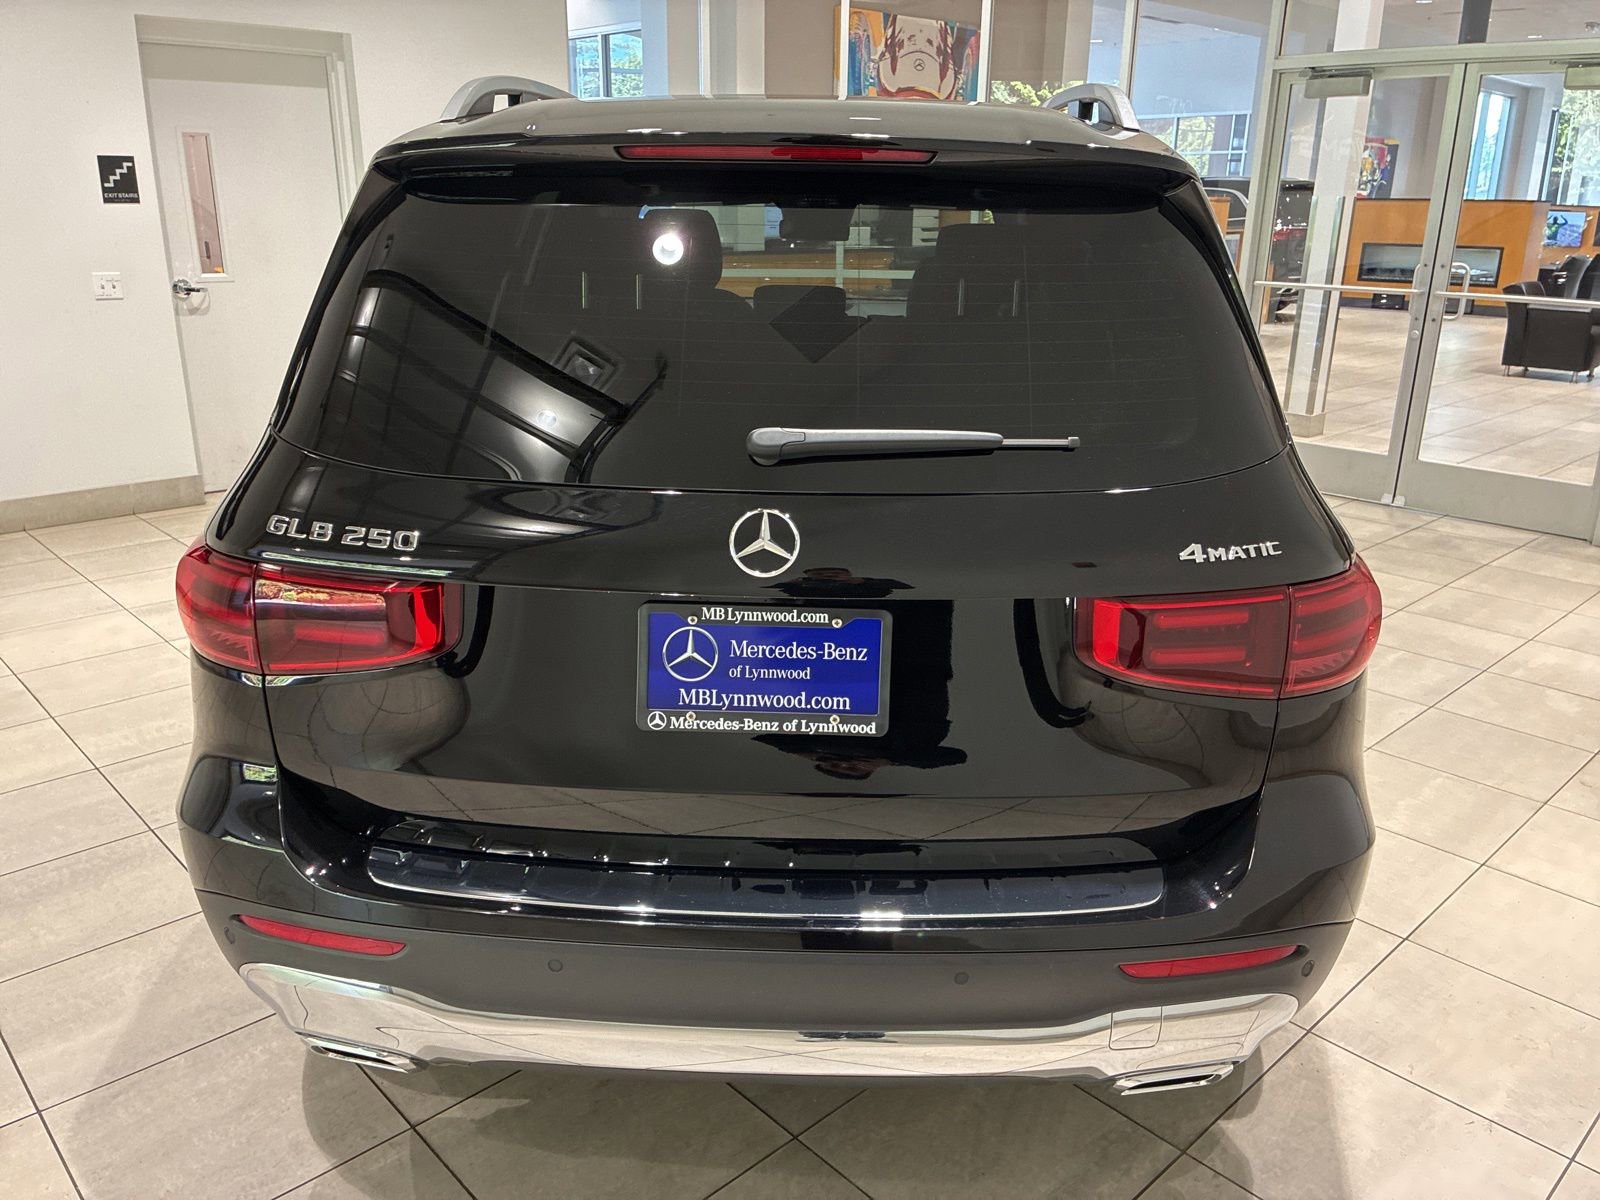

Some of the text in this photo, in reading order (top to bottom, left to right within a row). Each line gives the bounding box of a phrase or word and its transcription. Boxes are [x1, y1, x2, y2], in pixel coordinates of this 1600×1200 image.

[265, 514, 420, 551] GLB 250
[1179, 541, 1282, 563] 4MATIC
[729, 639, 867, 661] Mercedes-Benz
[729, 665, 811, 681] of Lynnwood
[678, 688, 851, 710] MBLynnwood.com
[669, 716, 876, 734] Mercedes-Benz of Lynnwood
